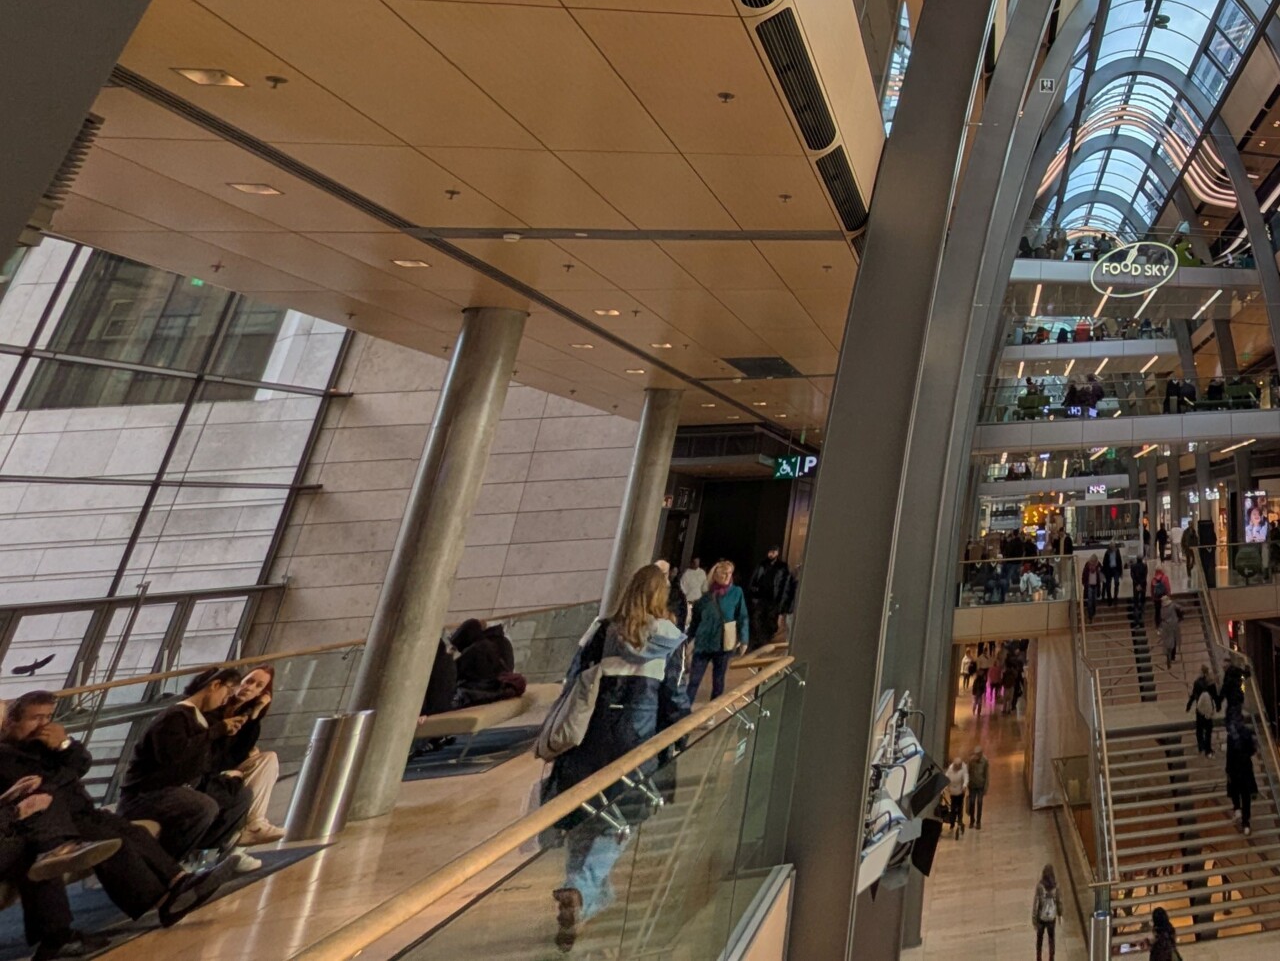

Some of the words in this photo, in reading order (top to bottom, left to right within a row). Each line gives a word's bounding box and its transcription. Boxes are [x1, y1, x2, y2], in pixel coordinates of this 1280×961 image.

[1102, 261, 1141, 276] FOOD
[1144, 264, 1169, 276] SKY
[804, 456, 817, 473] P
